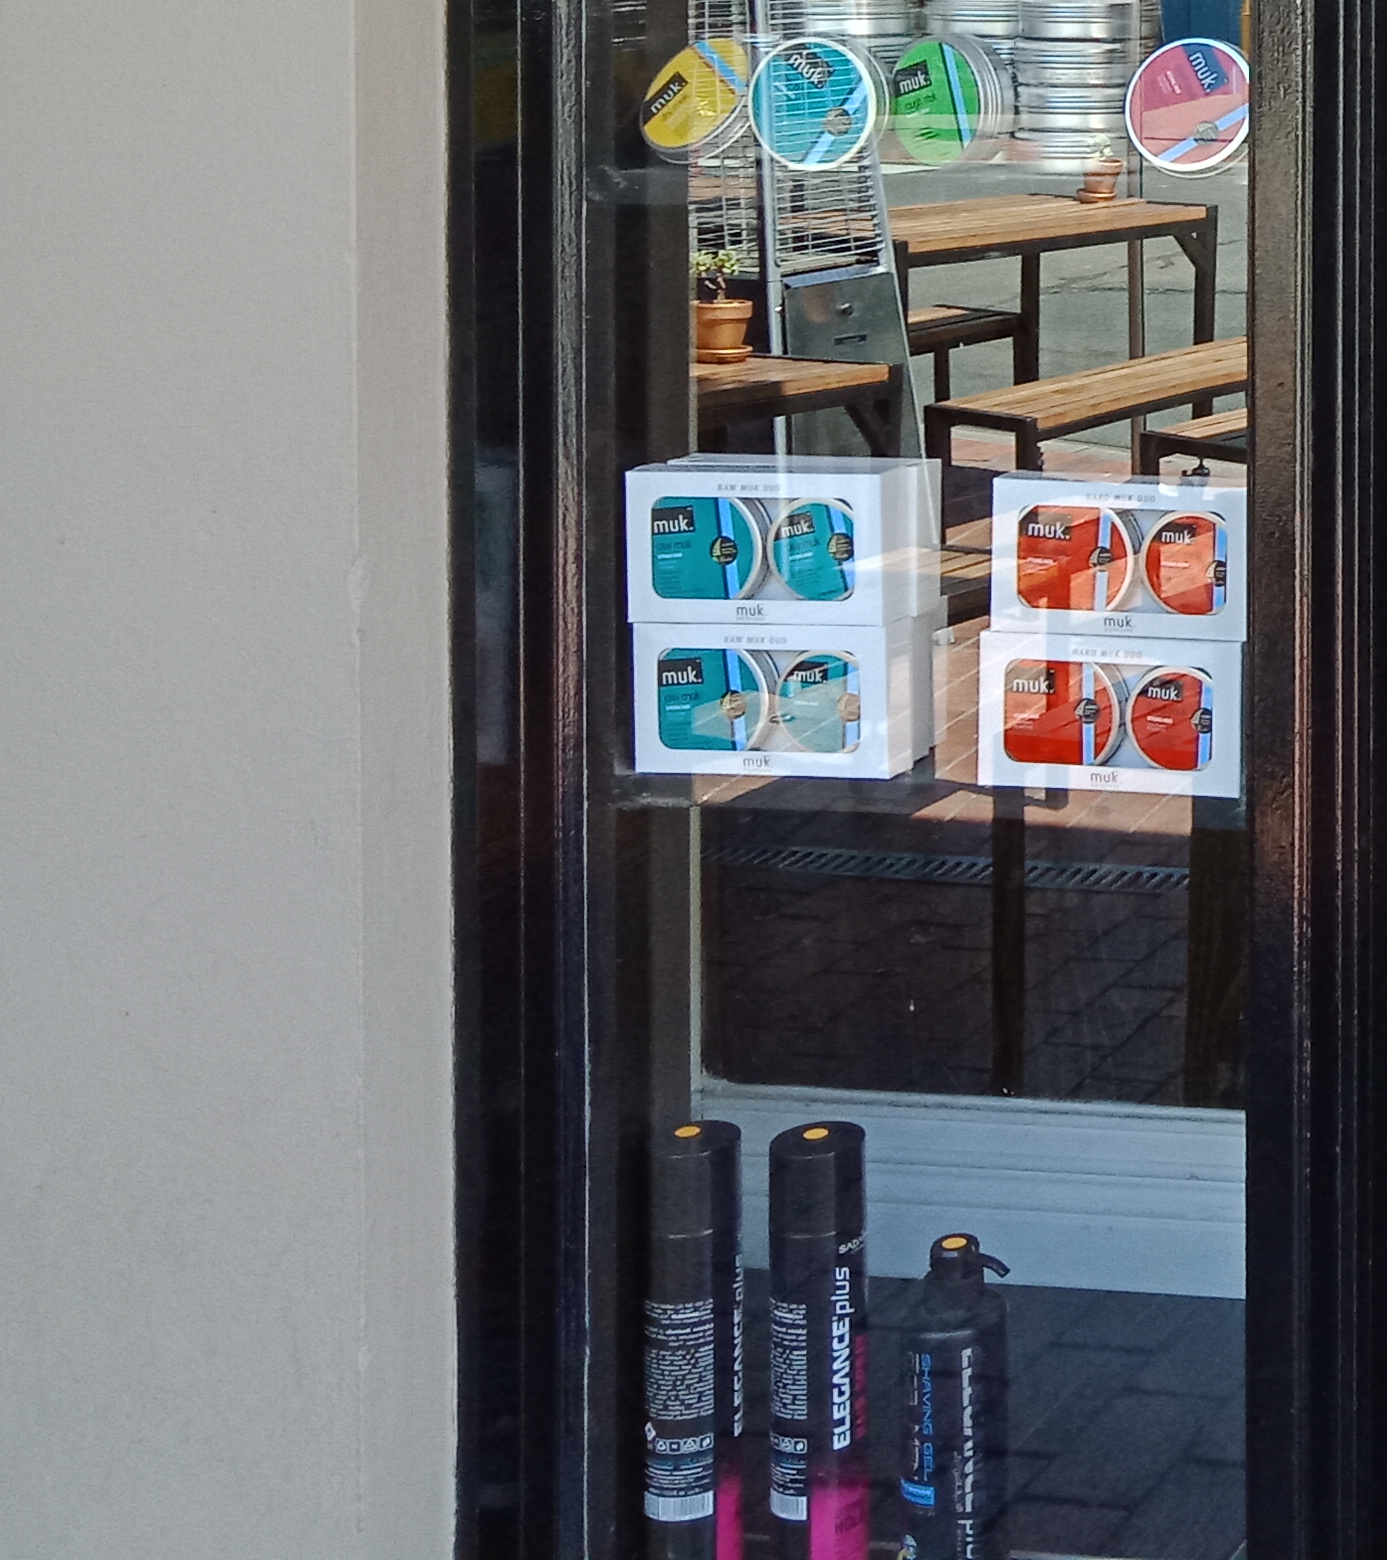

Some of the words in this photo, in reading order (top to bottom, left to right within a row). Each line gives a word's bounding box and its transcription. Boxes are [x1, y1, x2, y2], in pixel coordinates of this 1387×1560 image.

[899, 72, 931, 94] muk.
[650, 80, 687, 114] muk.
[653, 514, 694, 534] muk.
[781, 520, 815, 538] muk.
[1027, 522, 1071, 540] muk.
[736, 604, 765, 617] muk
[1103, 616, 1133, 628] muk
[662, 666, 702, 685] muk.
[1013, 677, 1055, 695] muk.
[1147, 684, 1182, 702] muk.
[1090, 771, 1119, 783] muk
[830, 1266, 855, 1313] plus
[832, 1316, 852, 1452] ELEGANCE
[921, 1352, 934, 1436] SHAVING
[923, 1442, 935, 1482] GEL
